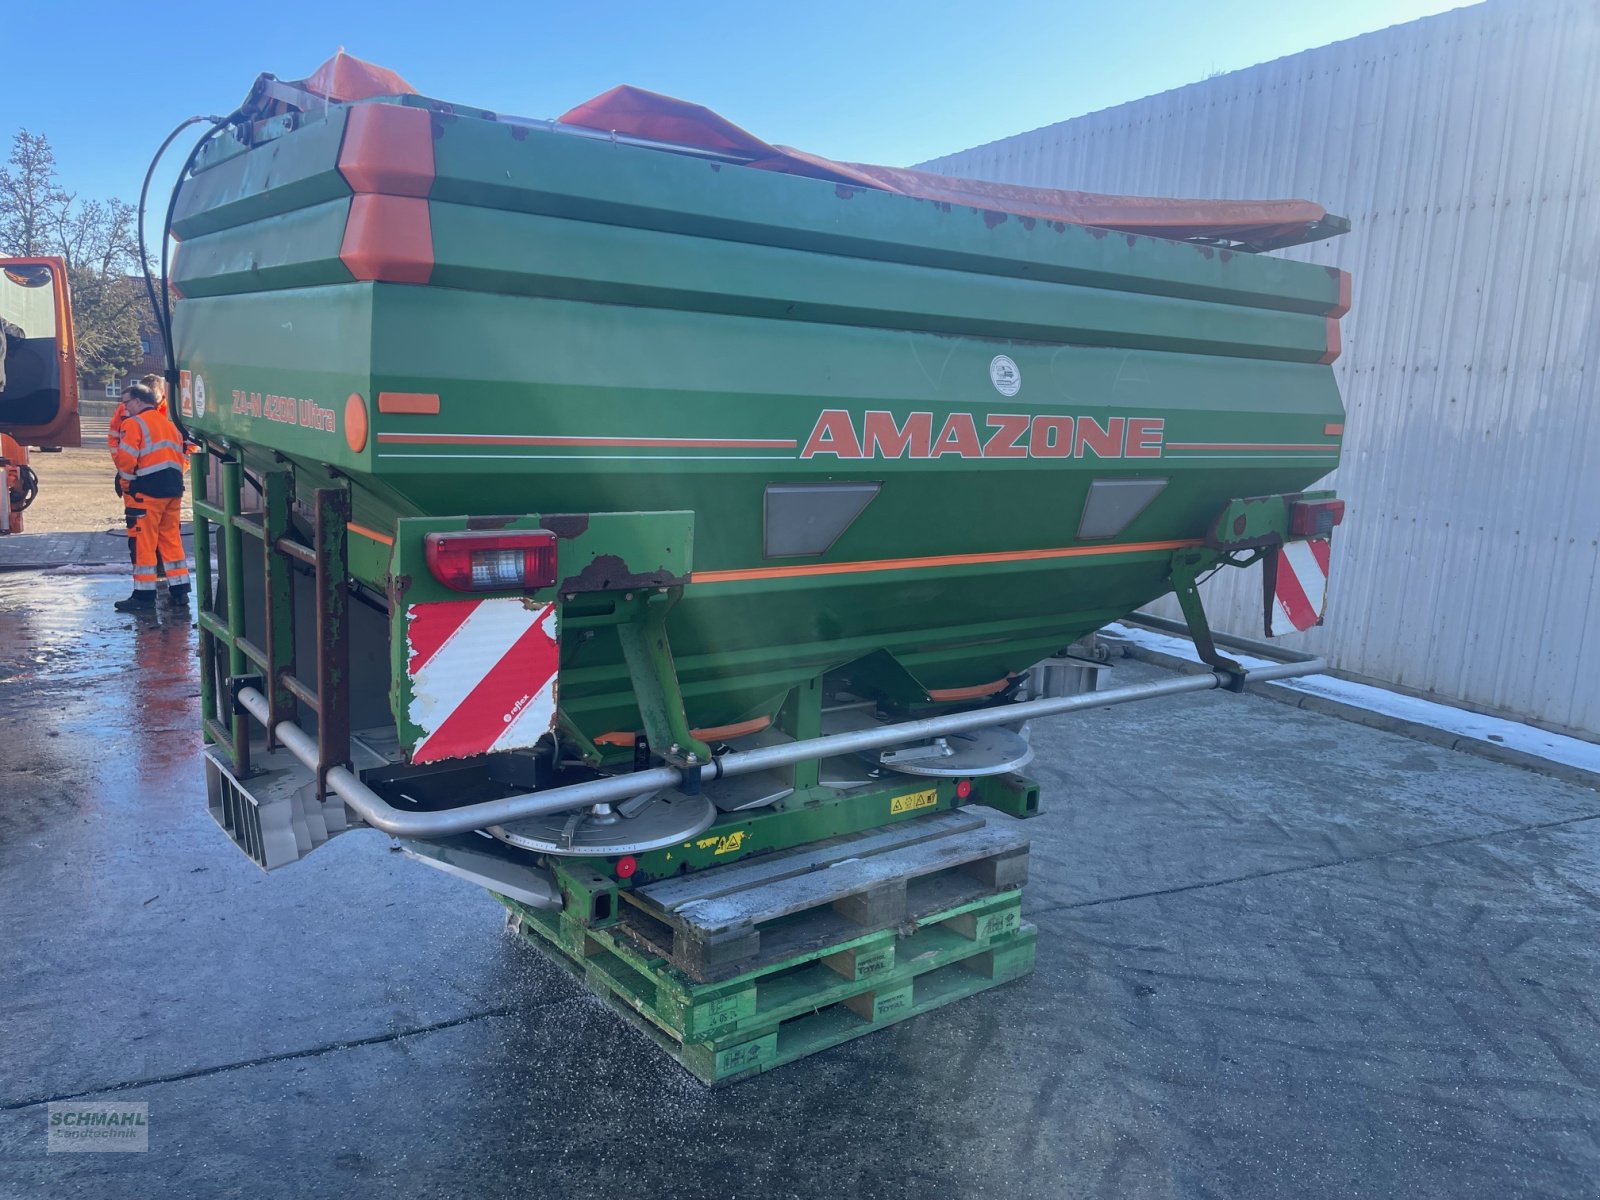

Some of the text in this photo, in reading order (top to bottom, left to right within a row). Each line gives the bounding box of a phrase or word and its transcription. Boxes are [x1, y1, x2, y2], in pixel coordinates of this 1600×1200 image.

[231, 389, 262, 418] ZA-M
[263, 394, 297, 425] 4200
[299, 398, 336, 432] Ultra
[800, 408, 1165, 459] AMAZONE
[510, 693, 530, 715] reflex
